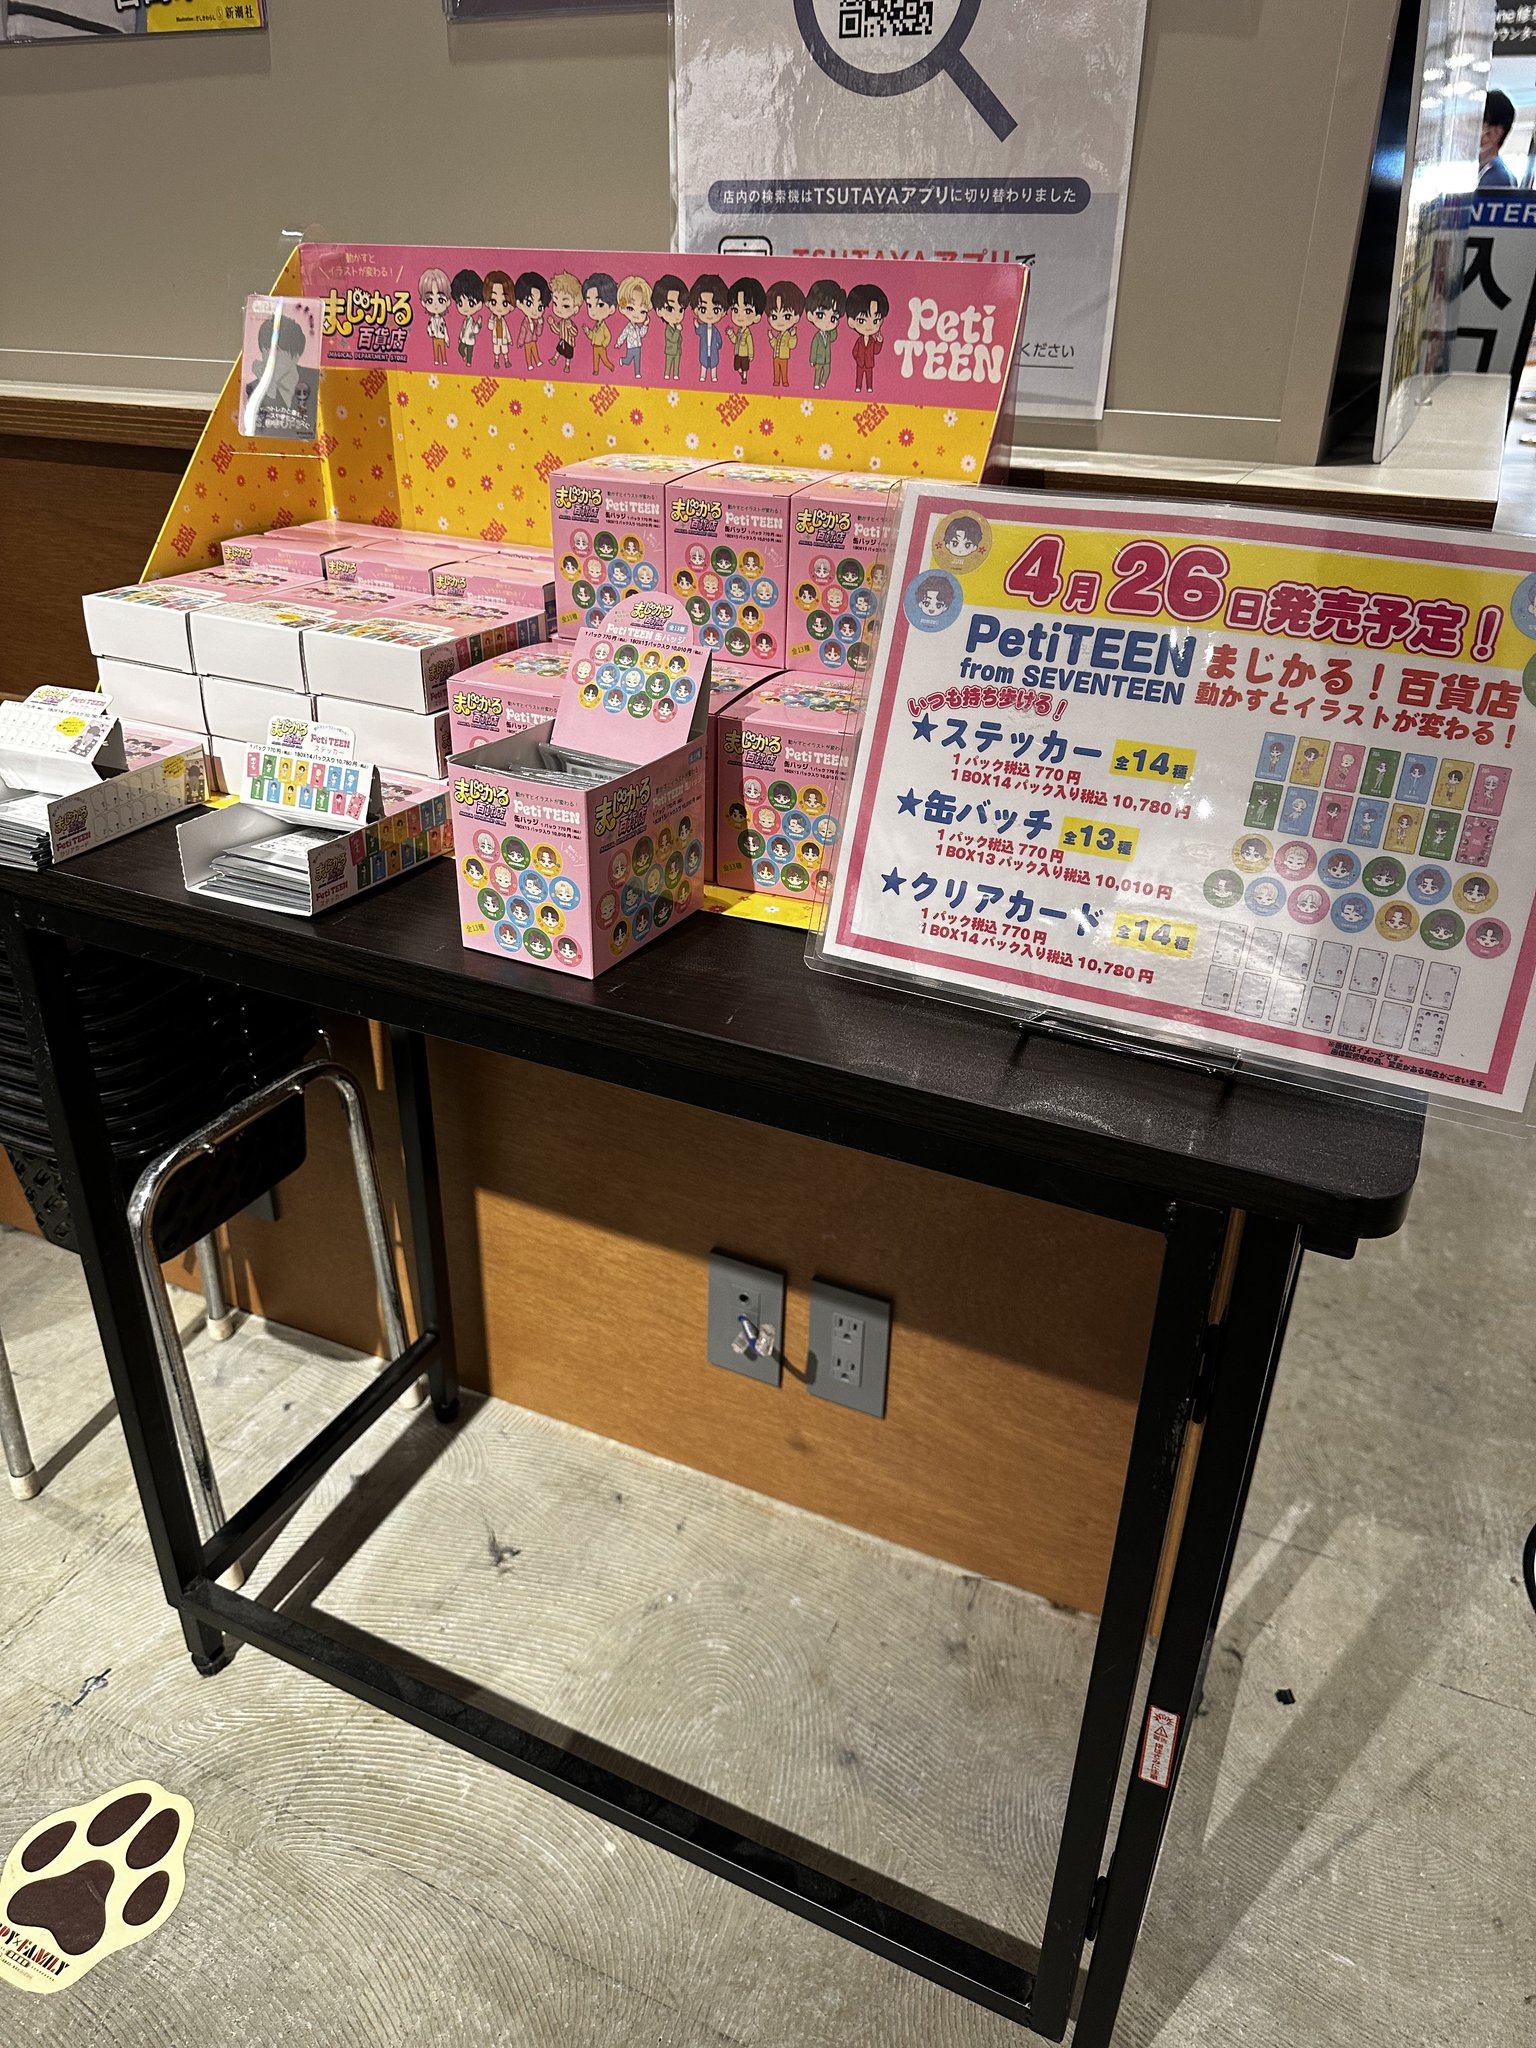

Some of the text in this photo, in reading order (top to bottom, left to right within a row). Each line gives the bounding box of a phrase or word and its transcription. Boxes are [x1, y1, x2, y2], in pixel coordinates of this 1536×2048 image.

[225, 5, 255, 20] 新潮社
[722, 185, 1077, 206] 店内の検索機はTSUTAYAアプリに切り替わりました
[321, 286, 413, 338] まじかる
[907, 296, 997, 344] Peti
[357, 327, 408, 353] 百貨店
[1021, 341, 1075, 358] ください
[893, 339, 1005, 385] TEEN
[555, 484, 603, 510] まじかる
[605, 498, 660, 515] Peti TEEN
[670, 496, 723, 523] まじかる
[724, 511, 783, 529] Peti TEEN
[795, 508, 852, 535] まじかる
[853, 523, 881, 539] Peti
[1003, 534, 1504, 662] 4月26日発売予定！
[606, 622, 626, 635] Peti
[627, 627, 654, 639] TEEN
[965, 613, 1197, 678] PetiTEEN
[960, 657, 1185, 705] from SEVENTEEN
[1205, 643, 1522, 720] まじかる！百貨店
[452, 690, 504, 716] まじかる
[505, 708, 530, 723] Peti
[907, 685, 1068, 721] いつも持ち歩ける！
[1194, 681, 1517, 749] 動かすとイラストが変わる！
[329, 737, 351, 749] TEEN
[723, 729, 782, 755] まじかる
[941, 717, 1189, 780] ステッカー 全14種
[784, 746, 849, 767] Peti TEEN
[454, 777, 510, 807] まじかる
[513, 799, 581, 825] Peti TEEN
[594, 775, 651, 838] まじかる
[925, 790, 1133, 856] 缶バッチ 全13種
[912, 871, 1191, 951] クリアカード 全14種
